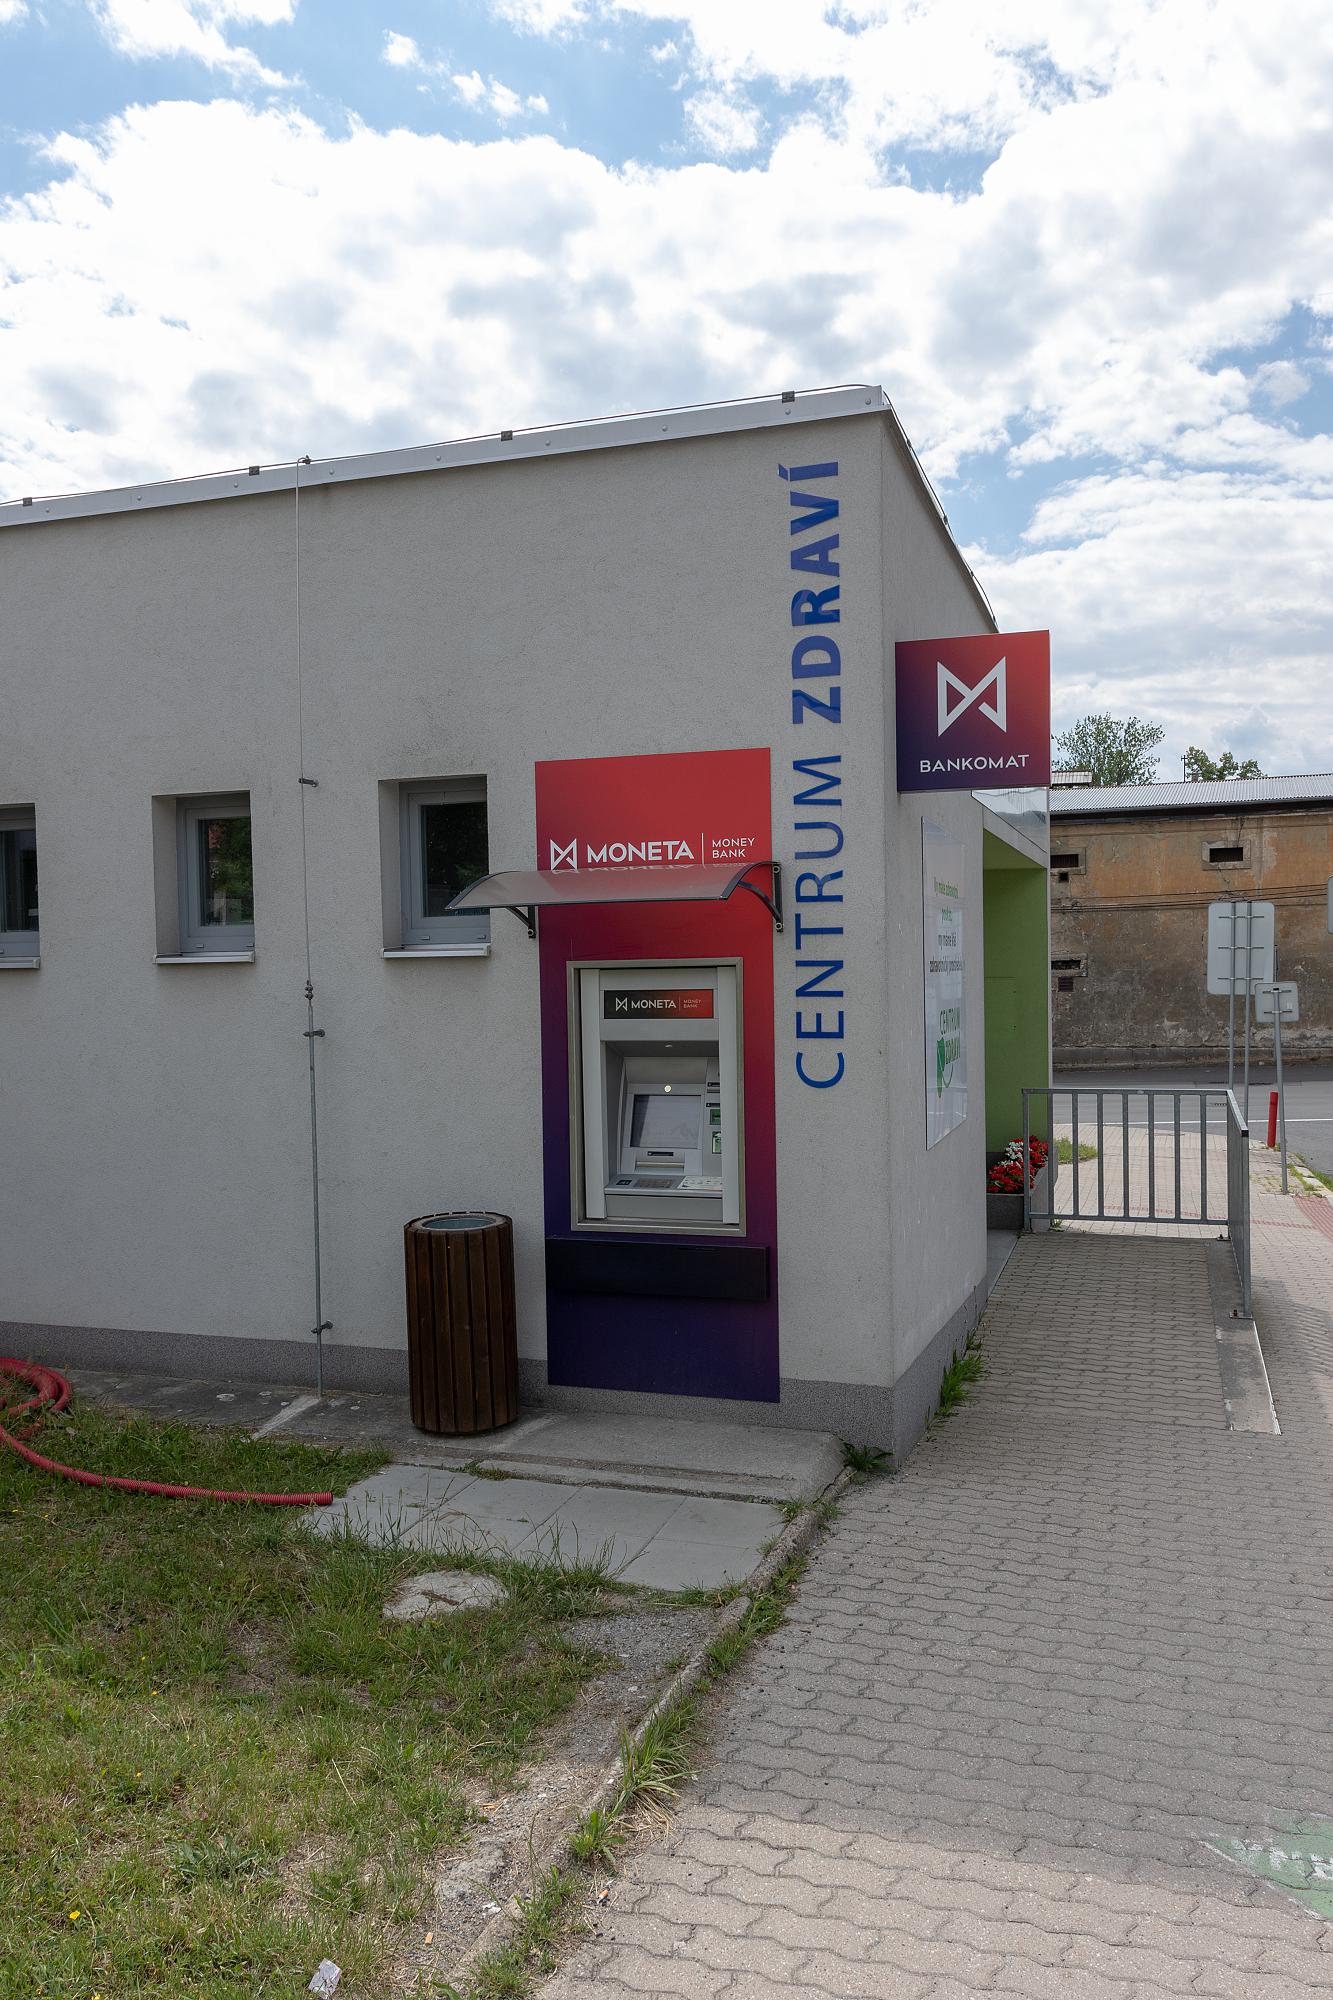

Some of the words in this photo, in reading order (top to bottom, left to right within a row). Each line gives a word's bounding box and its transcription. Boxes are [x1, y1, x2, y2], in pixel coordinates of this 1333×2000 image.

[778, 461, 842, 725] ZDRAVÍ
[920, 754, 1030, 773] BANKOMAT
[587, 840, 695, 863] MONETA
[711, 837, 755, 848] MONEY
[711, 848, 746, 859] BANK
[793, 755, 845, 1089] CENTRUM
[631, 999, 677, 1009] MONETA
